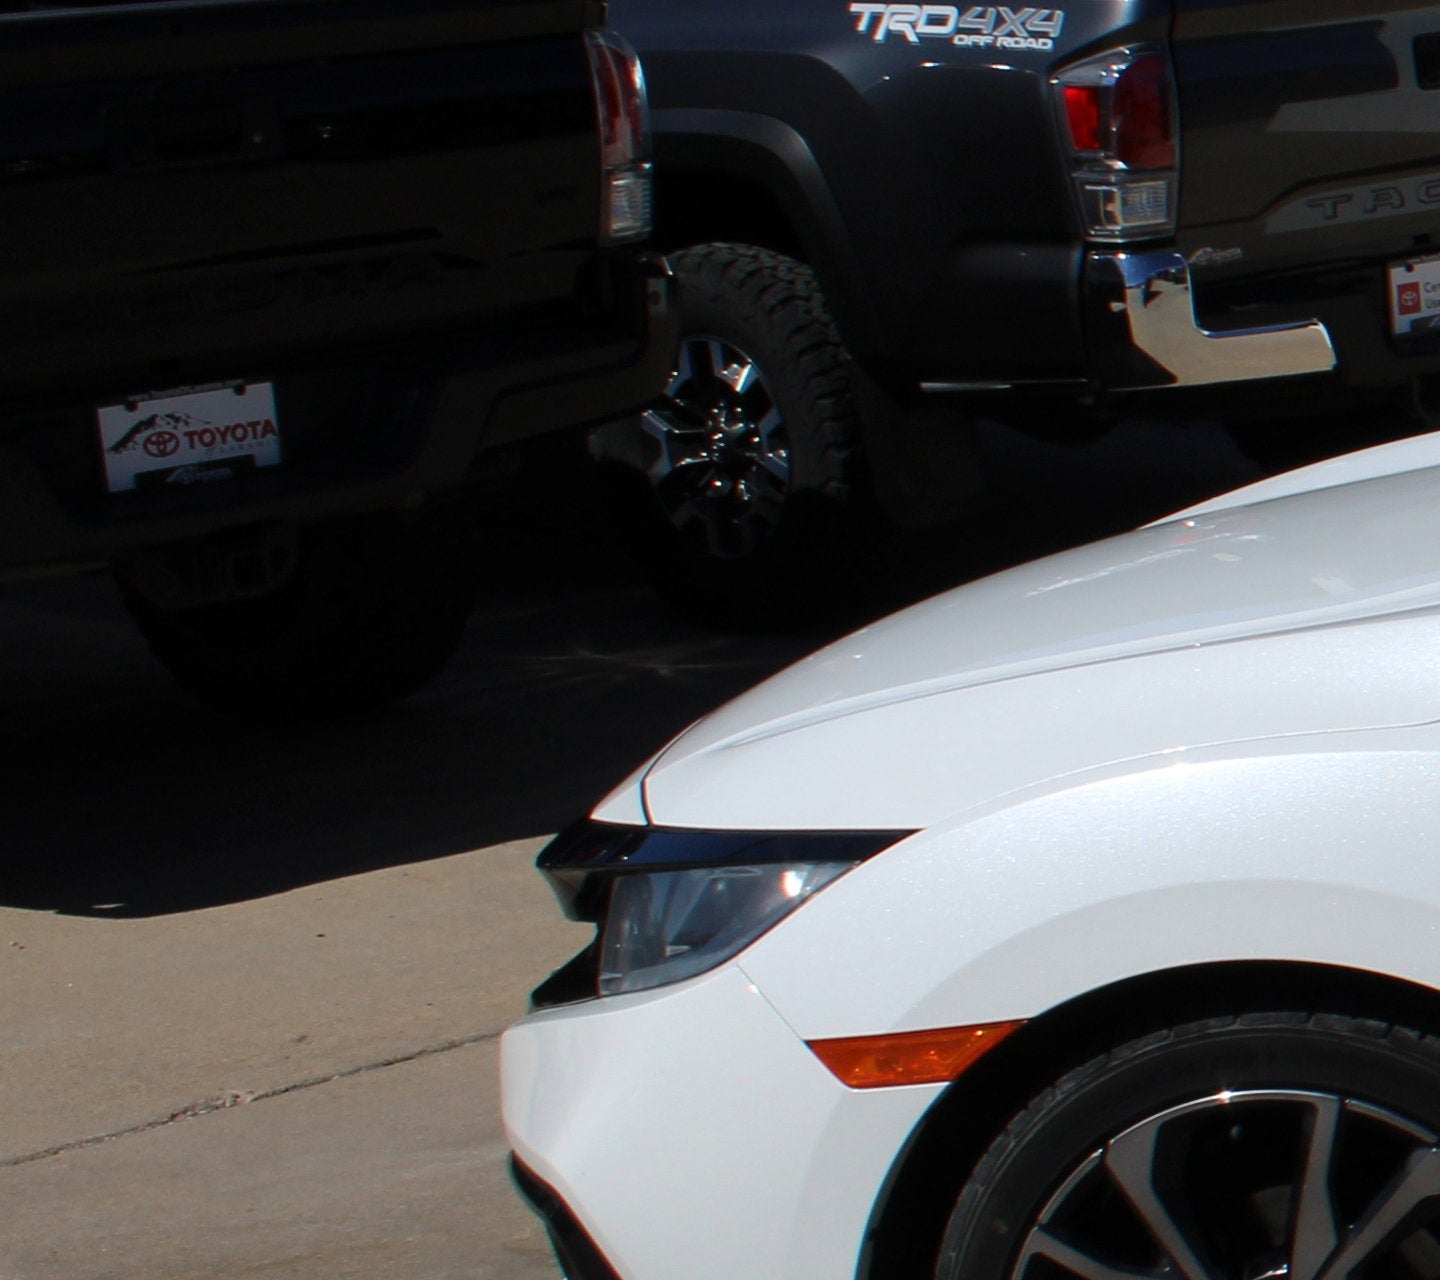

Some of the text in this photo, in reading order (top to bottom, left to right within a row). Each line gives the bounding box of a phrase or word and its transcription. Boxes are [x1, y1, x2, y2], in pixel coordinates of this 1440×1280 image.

[848, 2, 959, 44] TRD
[953, 34, 1054, 50] OFF ROAD
[184, 419, 279, 451] TOYOTA
